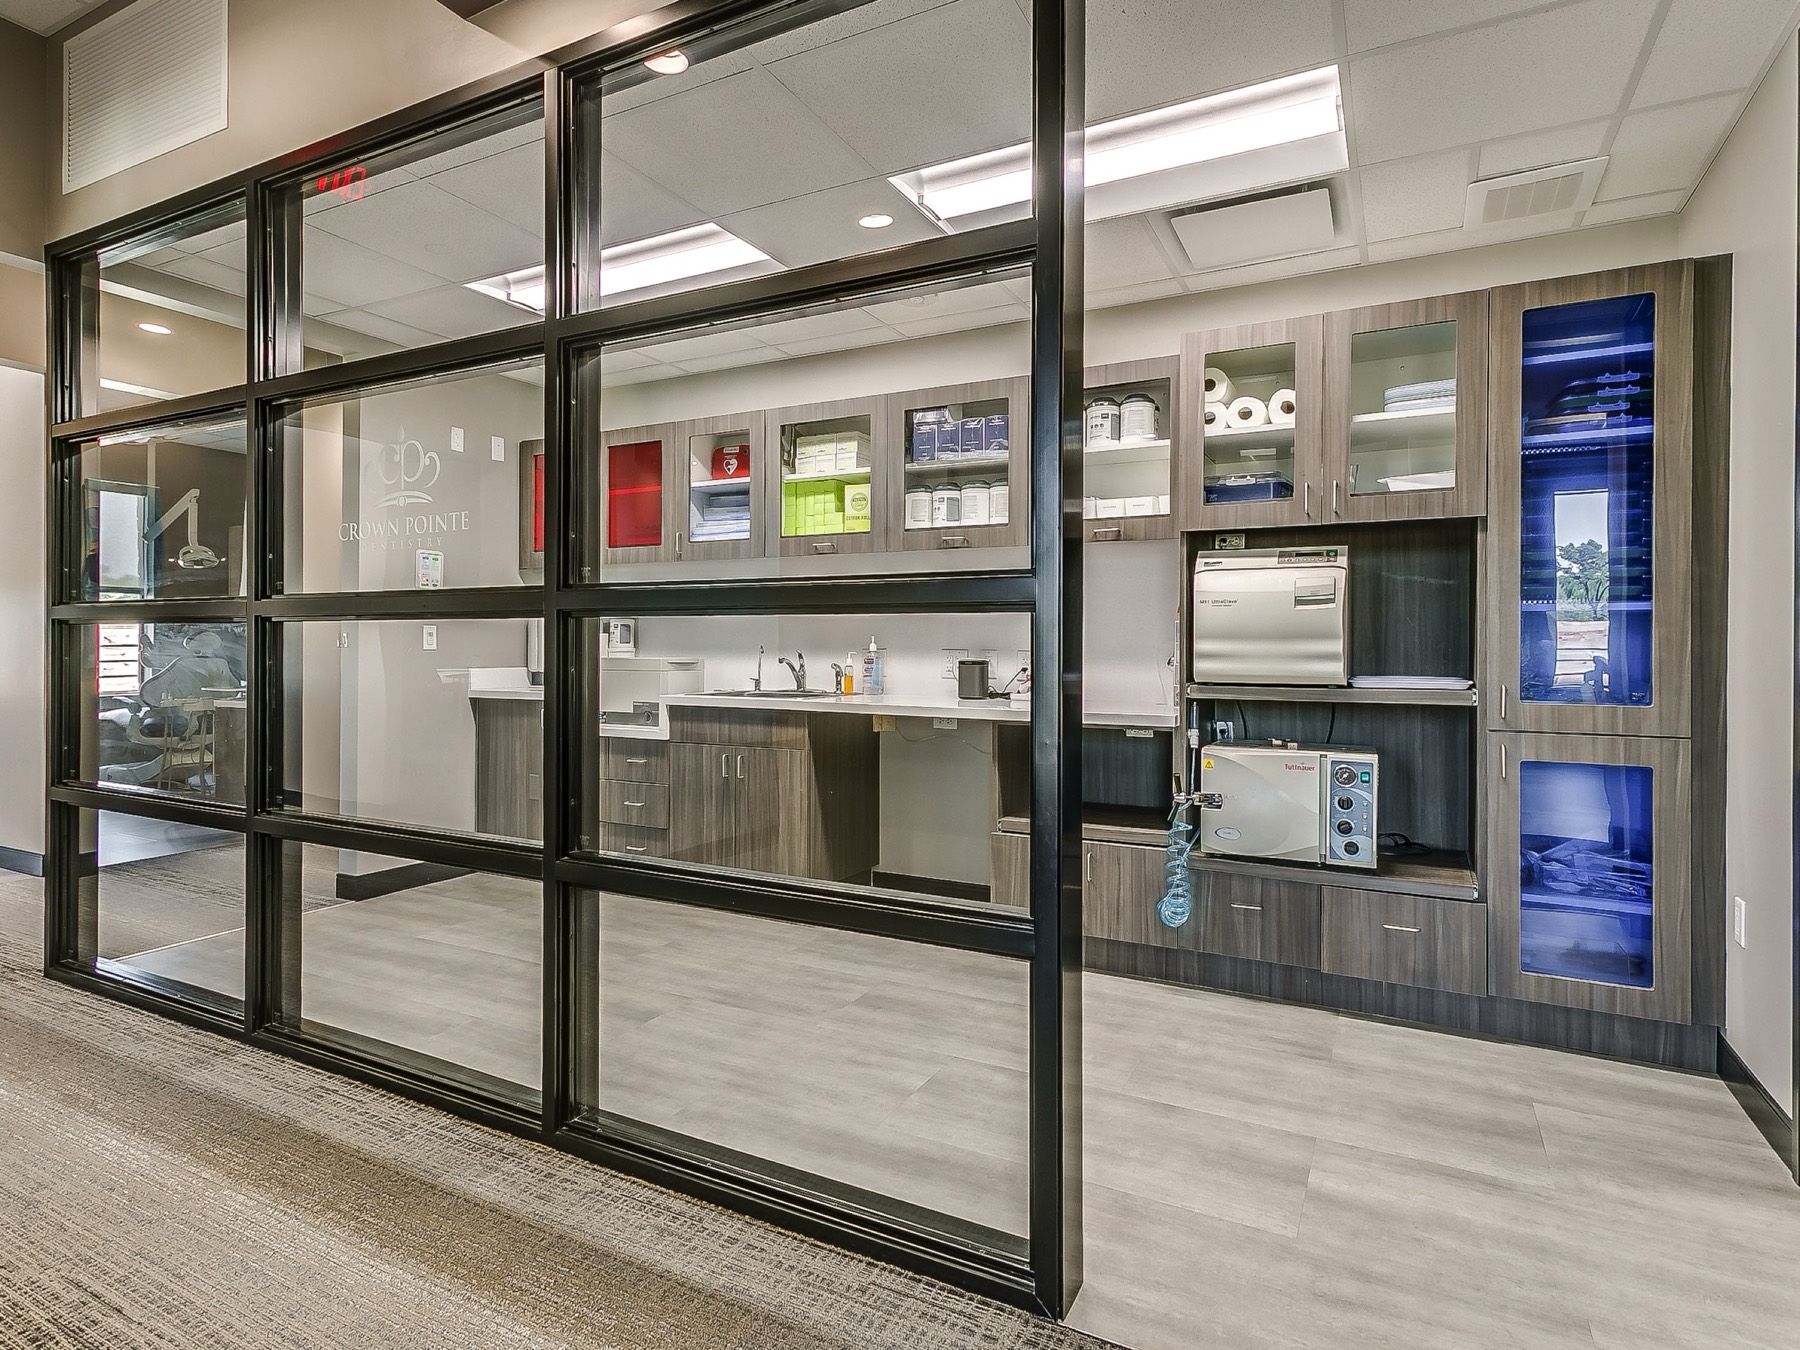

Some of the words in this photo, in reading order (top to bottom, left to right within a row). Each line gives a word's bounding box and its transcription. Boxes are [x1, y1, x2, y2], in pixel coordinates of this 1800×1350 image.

[338, 519, 399, 541] CROWN
[405, 511, 469, 535] POINTE
[361, 537, 442, 552] DENTISTRY
[1284, 763, 1315, 771] Tuttnauer
